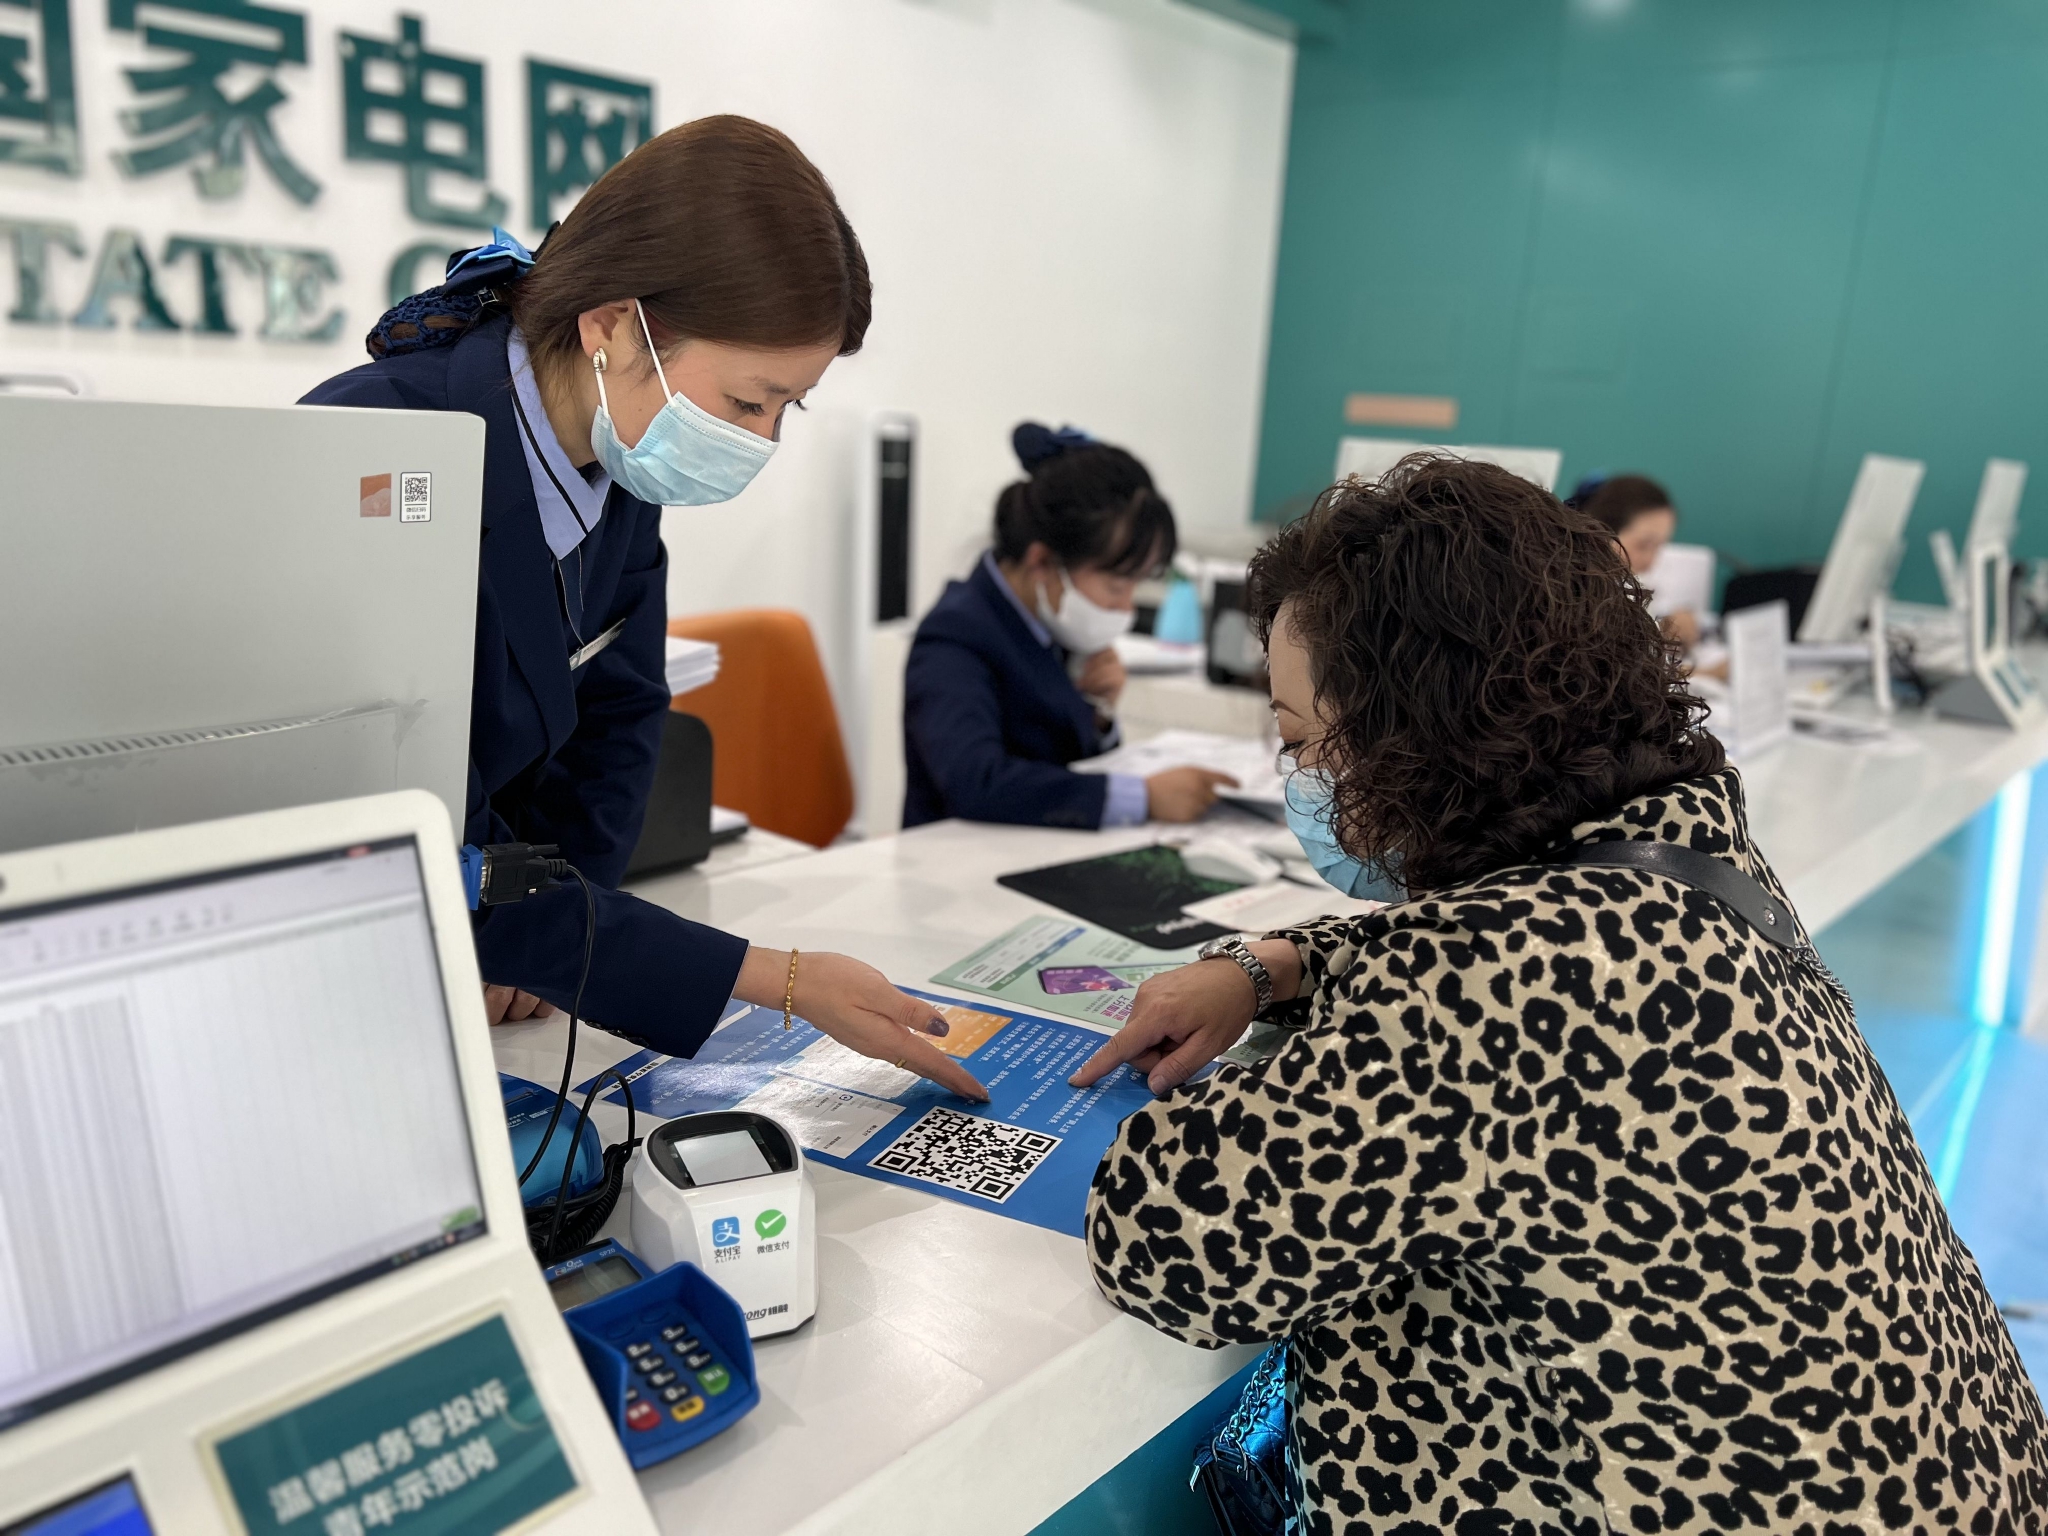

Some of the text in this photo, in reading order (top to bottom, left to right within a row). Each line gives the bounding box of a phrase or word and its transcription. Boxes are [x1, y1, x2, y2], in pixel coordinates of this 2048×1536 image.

[714, 1246, 740, 1258] 支付宝
[757, 1241, 789, 1254] 微信支付
[715, 1255, 741, 1263] ALIPAY
